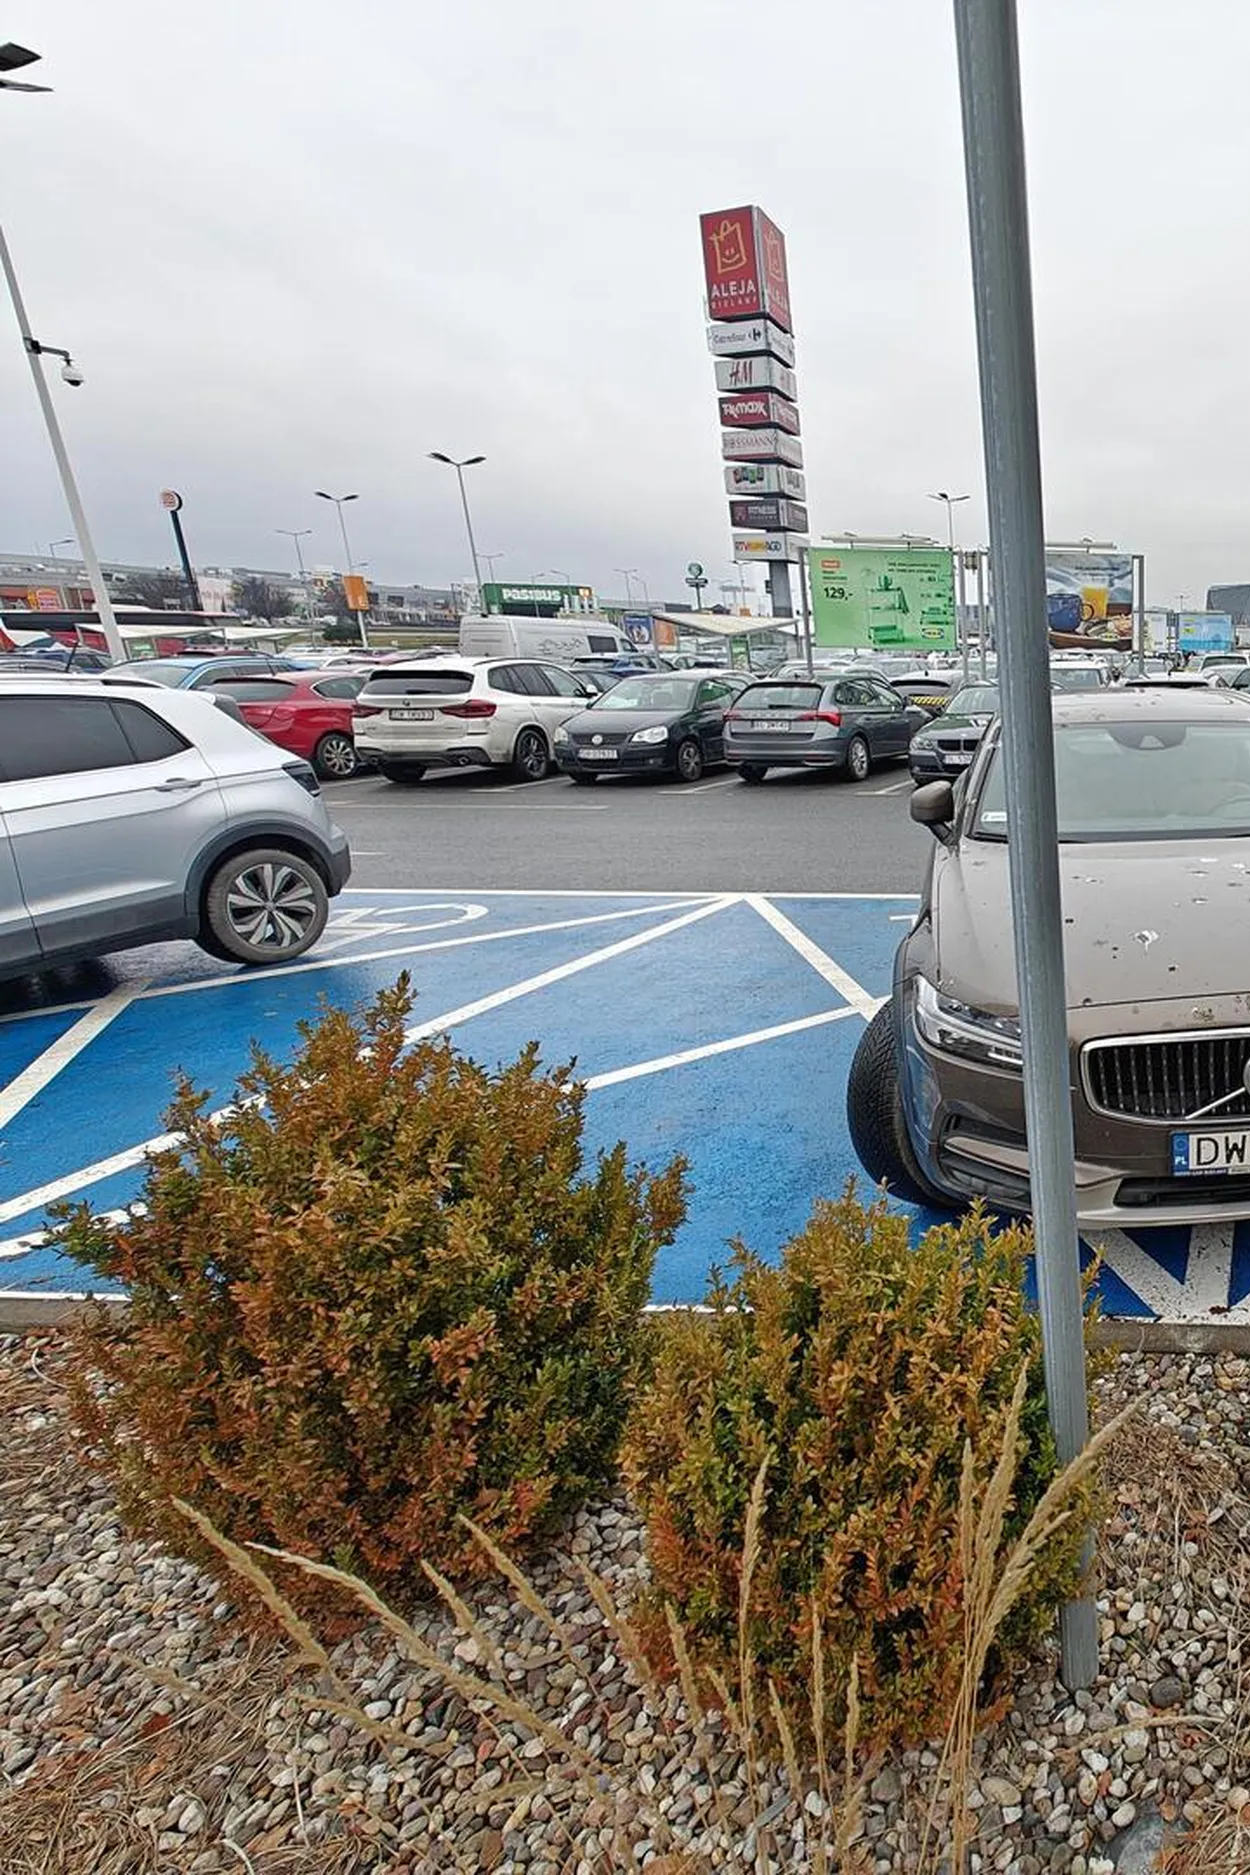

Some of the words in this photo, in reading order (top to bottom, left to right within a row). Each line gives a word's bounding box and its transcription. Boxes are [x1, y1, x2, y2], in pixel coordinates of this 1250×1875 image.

[711, 279, 757, 299] ALEJA
[1196, 1135, 1246, 1166] DW
[1174, 1156, 1188, 1166] PL
